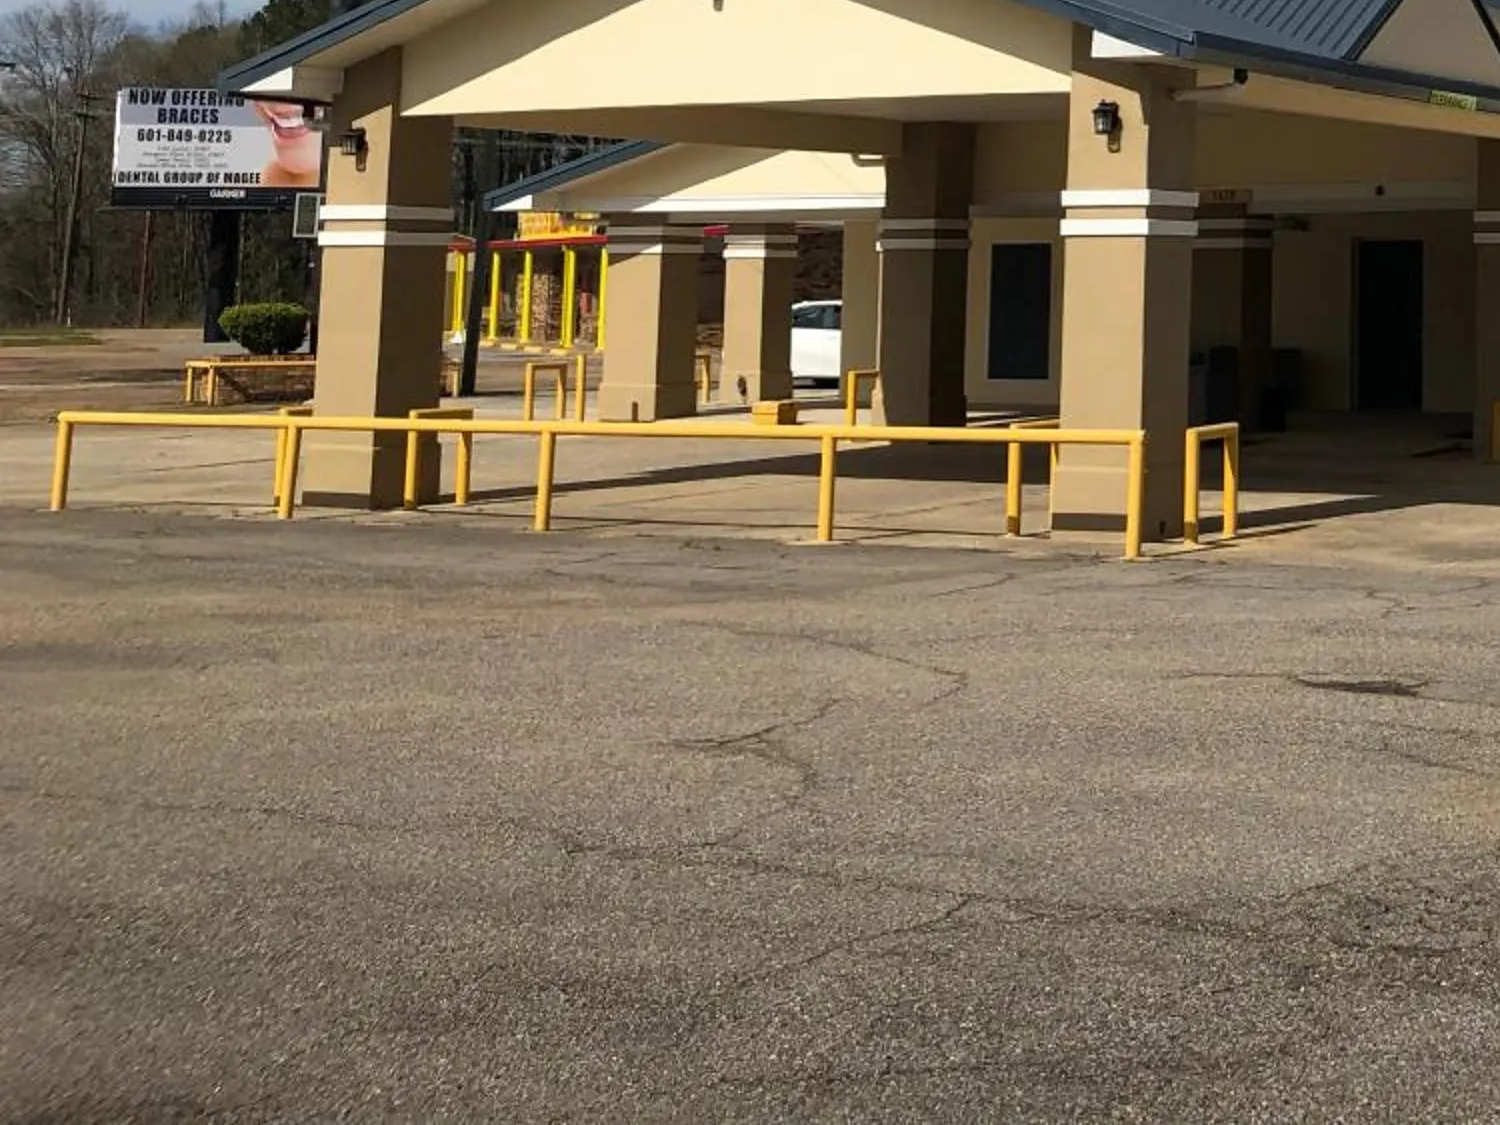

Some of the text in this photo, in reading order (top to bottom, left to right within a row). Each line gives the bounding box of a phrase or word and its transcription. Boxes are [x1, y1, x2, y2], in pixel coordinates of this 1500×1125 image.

[128, 89, 166, 106] NOW
[157, 108, 219, 125] BRACES
[137, 128, 233, 144] 601-849-0225
[118, 171, 261, 184] DENTAL GROUP OF MAGEE
